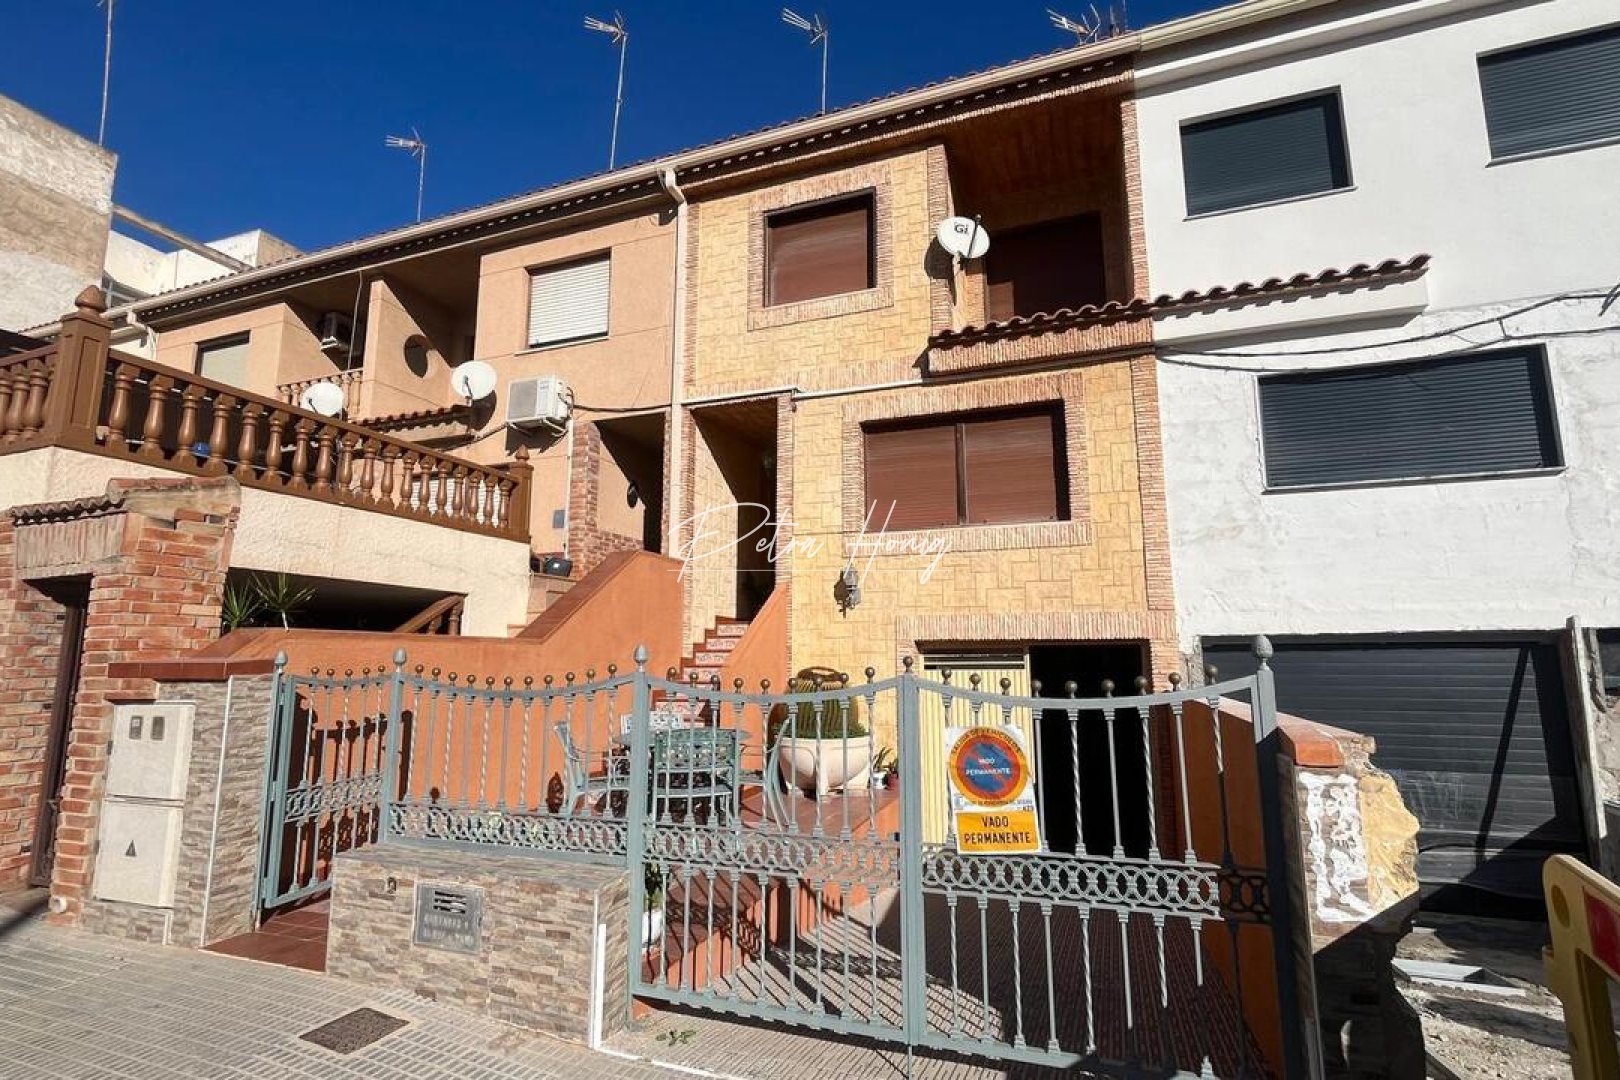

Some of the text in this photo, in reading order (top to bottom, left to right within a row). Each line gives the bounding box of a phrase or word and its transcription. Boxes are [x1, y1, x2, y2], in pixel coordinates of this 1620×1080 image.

[966, 768, 1011, 776] PERMANENTE
[982, 816, 1009, 828] VADO
[964, 832, 1031, 844] PERMANENTE
